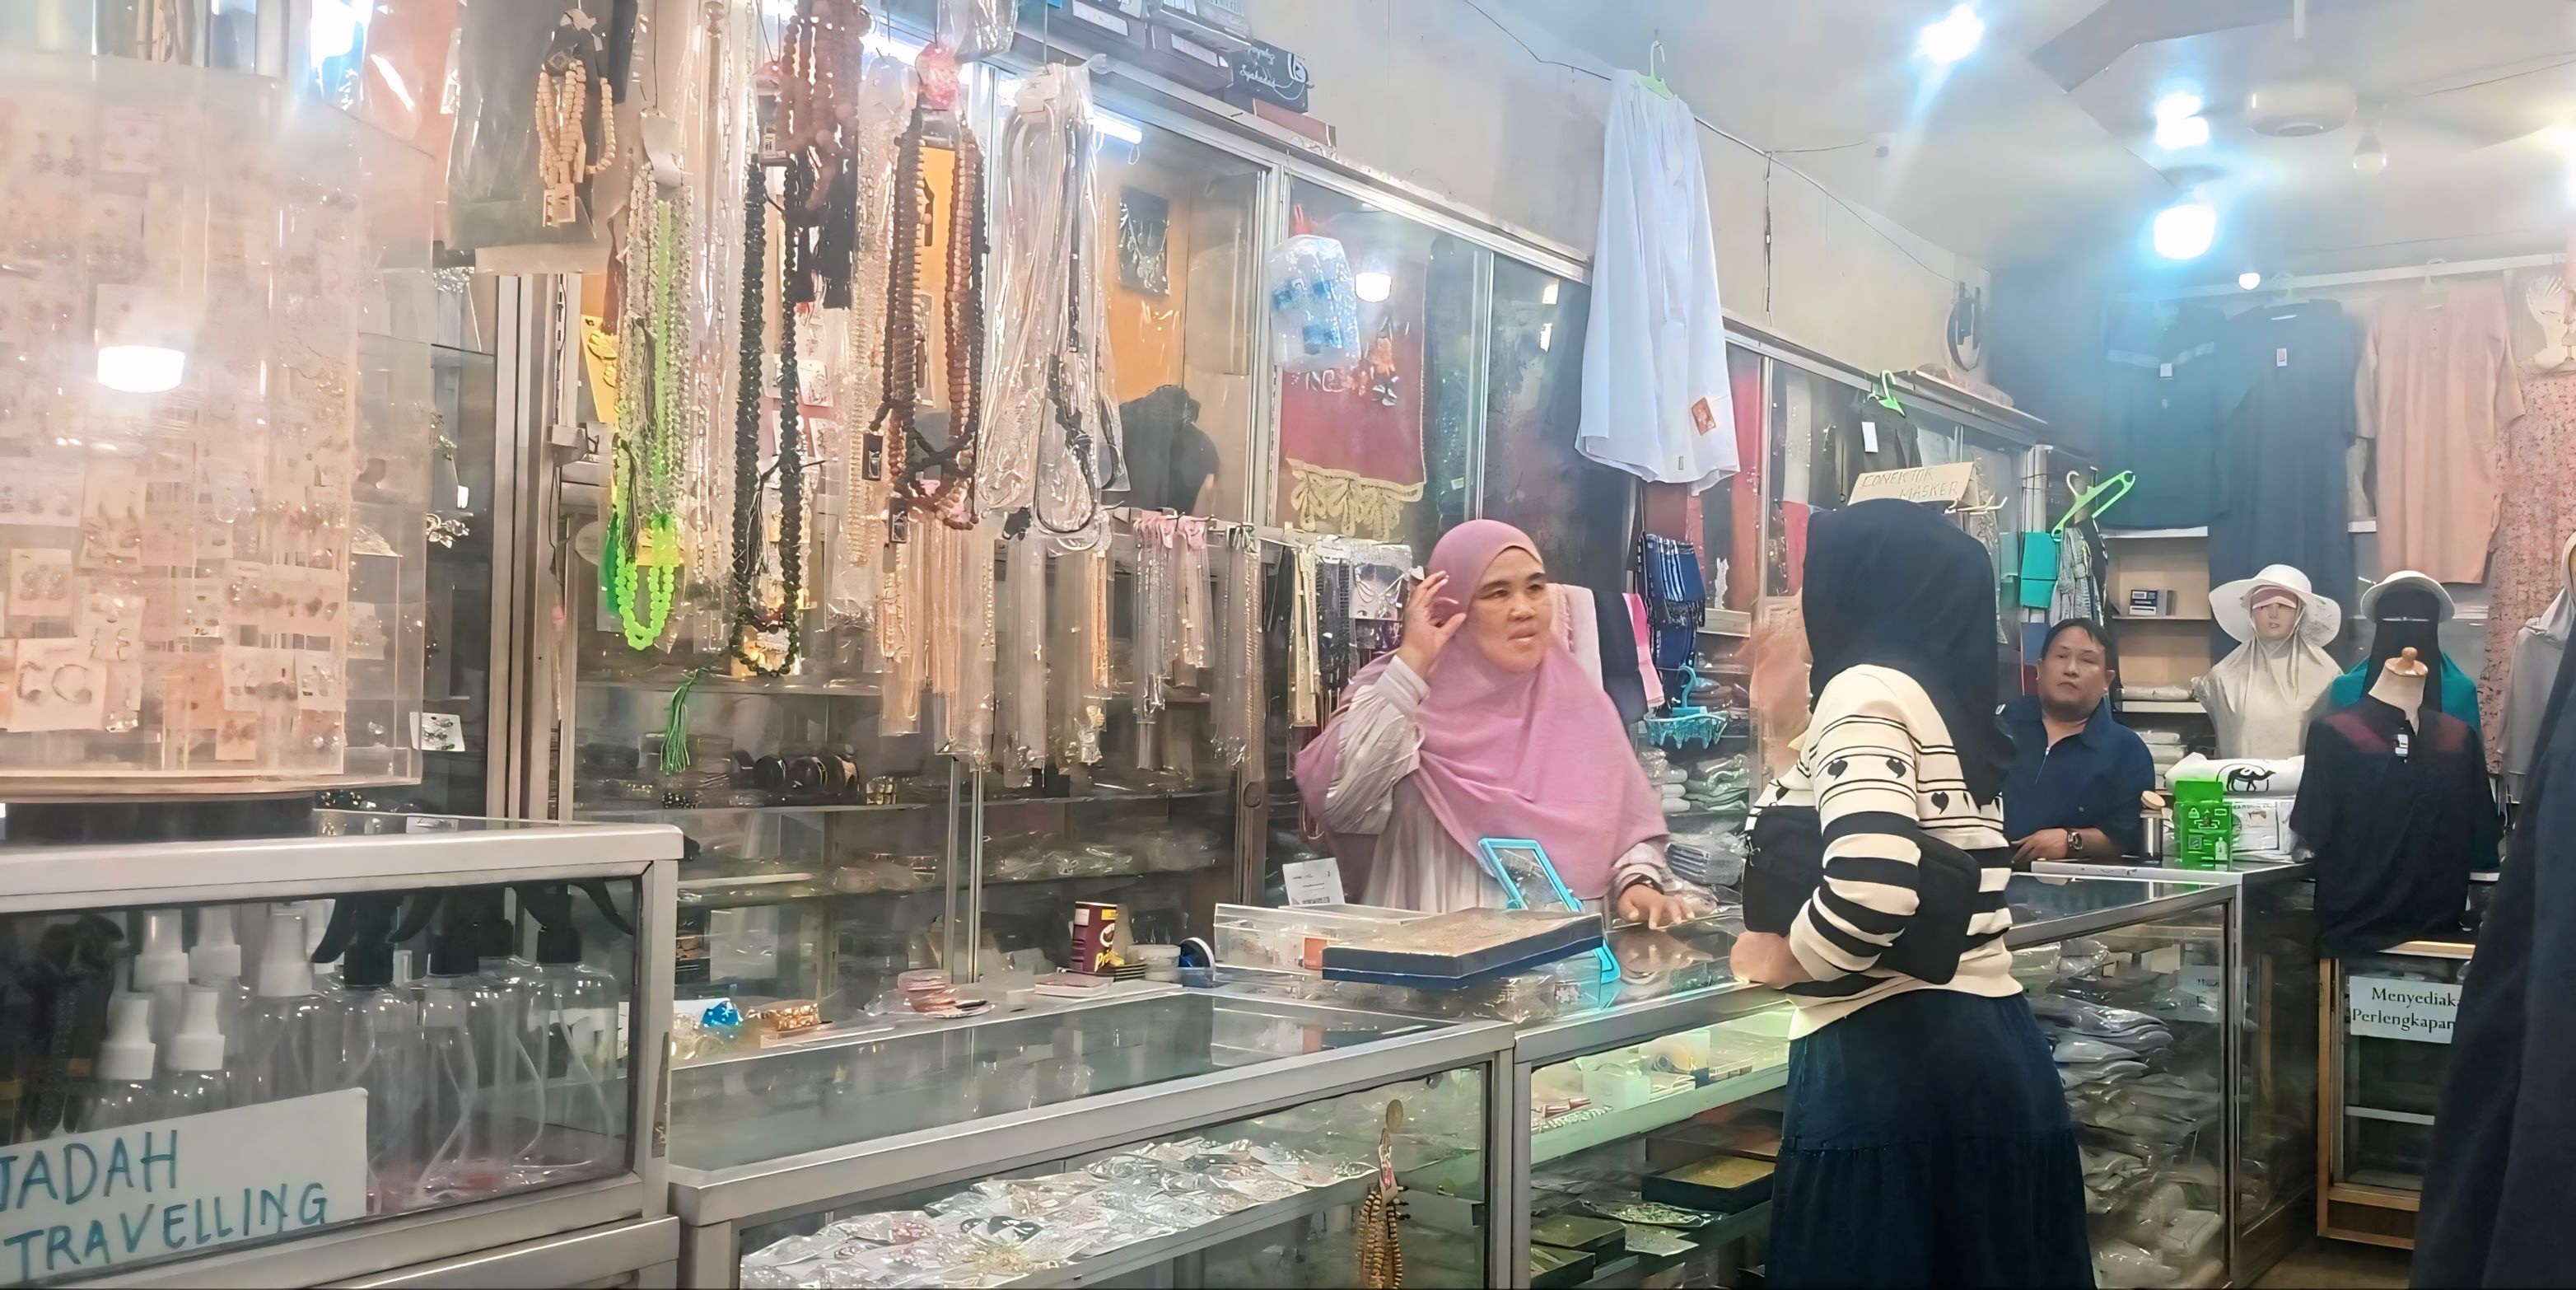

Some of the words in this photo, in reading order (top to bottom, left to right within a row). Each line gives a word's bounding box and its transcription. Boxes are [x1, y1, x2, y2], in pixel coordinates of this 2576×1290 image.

[1899, 481, 1958, 499] MASKER
[2372, 987, 2458, 1008] Menyediak
[4, 1183, 327, 1282] TRAVELLING
